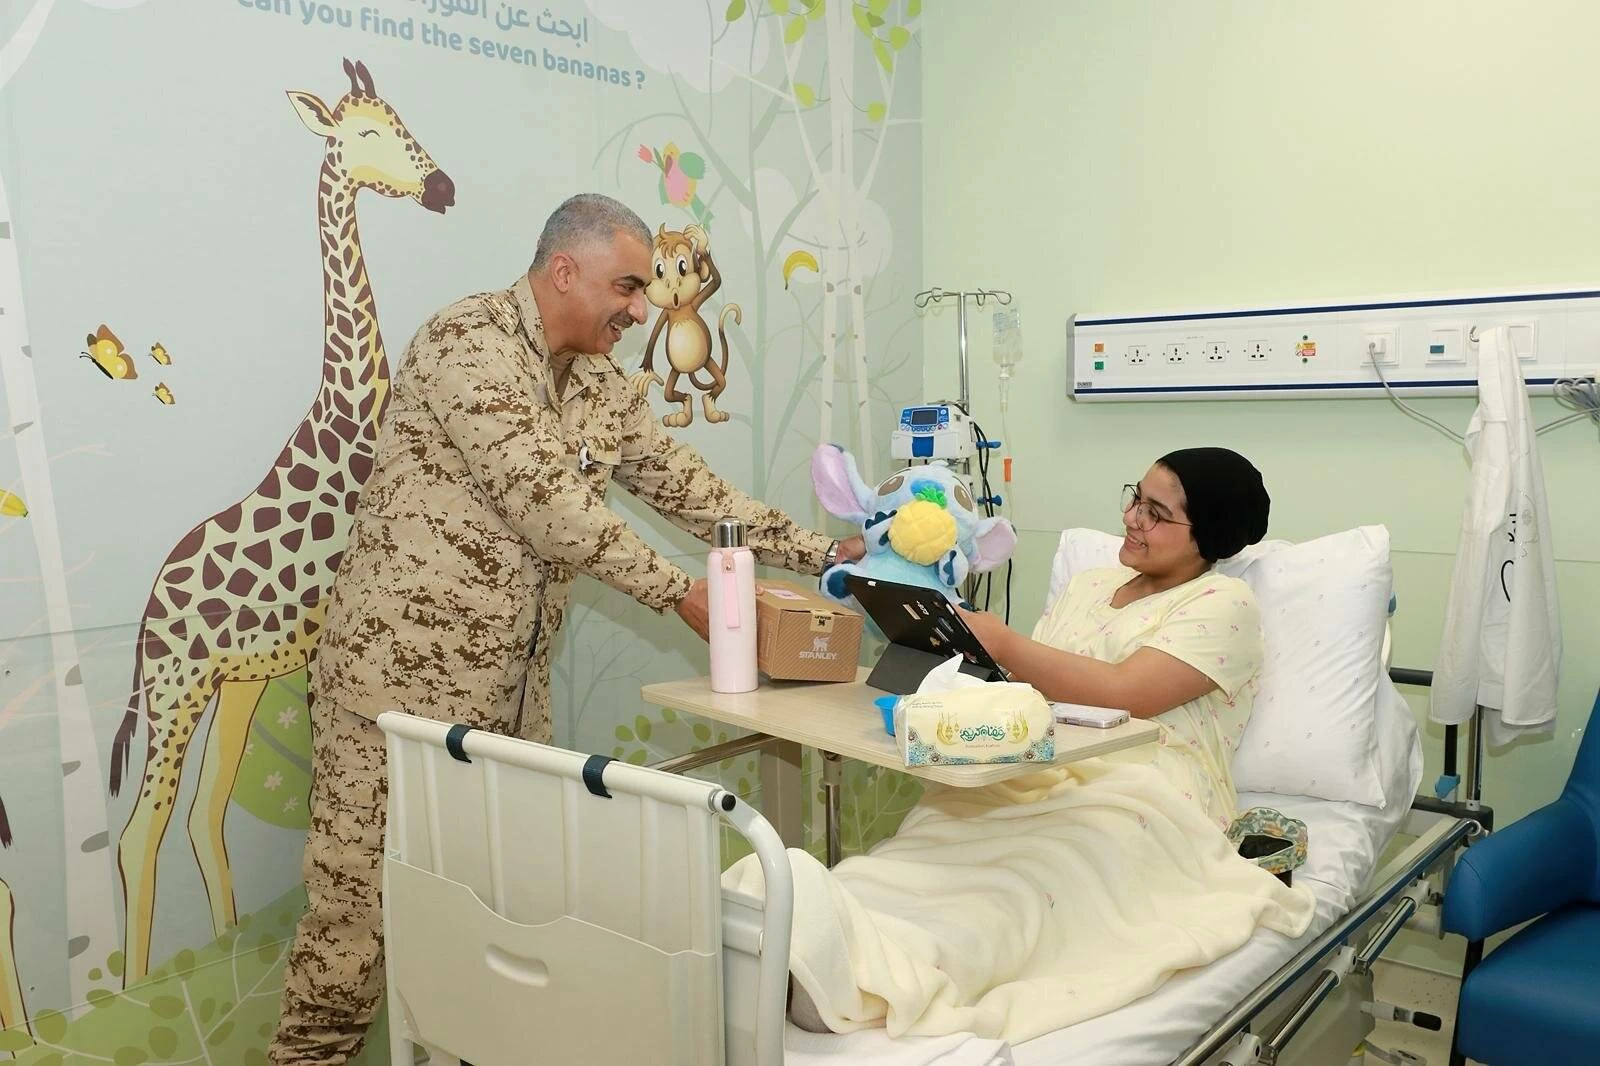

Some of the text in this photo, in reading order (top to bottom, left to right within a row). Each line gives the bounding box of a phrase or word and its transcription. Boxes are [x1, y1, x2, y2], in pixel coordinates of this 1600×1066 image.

[495, 2, 530, 31] عن
[536, 8, 588, 48] ابحث
[300, 1, 352, 28] you
[360, 7, 415, 41] find
[421, 22, 463, 51] the
[468, 36, 537, 67] seven
[543, 47, 632, 88] bananas
[799, 651, 837, 660] STANLEY
